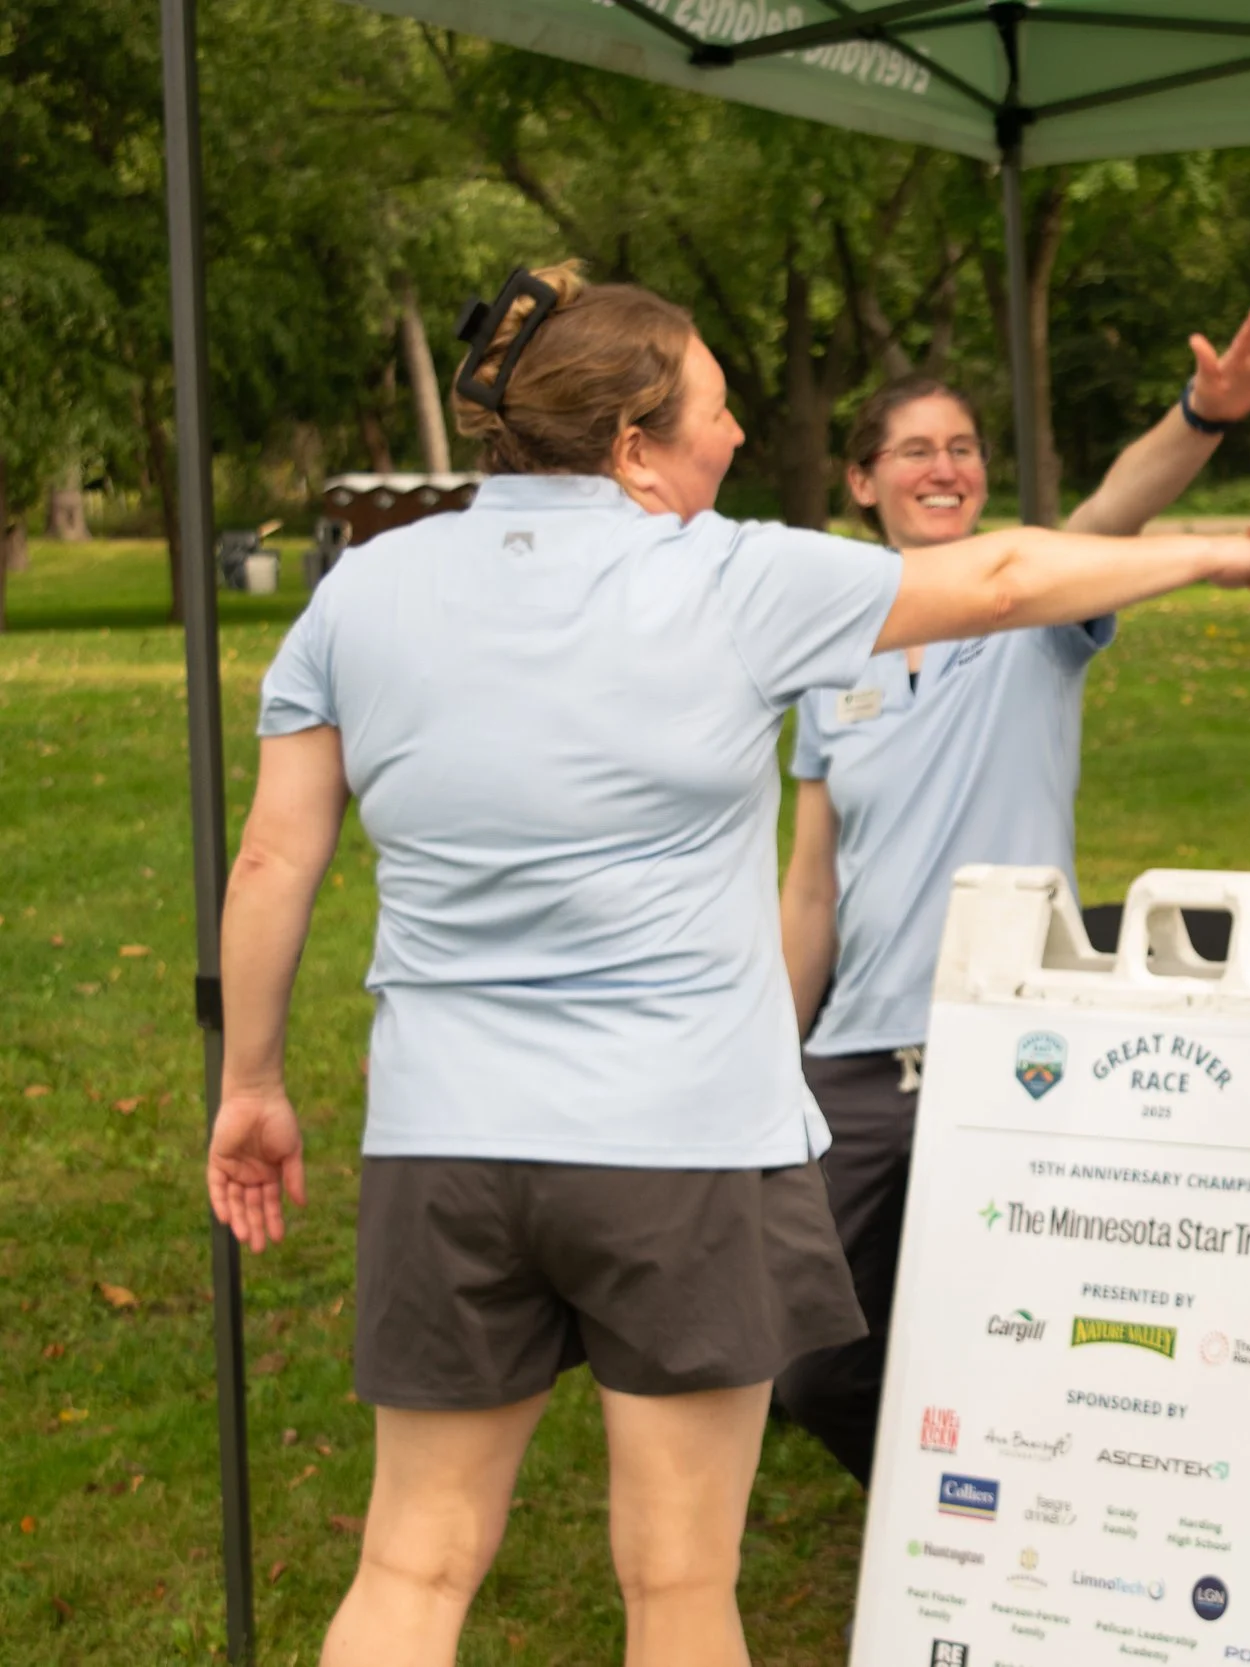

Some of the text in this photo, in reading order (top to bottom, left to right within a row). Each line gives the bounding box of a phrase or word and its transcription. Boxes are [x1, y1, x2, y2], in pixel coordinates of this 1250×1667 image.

[1092, 1032, 1232, 1090] GREAT RIVER
[1131, 1069, 1190, 1093] RACE
[1141, 1104, 1172, 1119] 2025
[1029, 1160, 1066, 1175] 15TH
[1070, 1163, 1182, 1186] ANNIVERSARY
[1008, 1201, 1044, 1235] The
[1050, 1205, 1171, 1248] Minnesota
[1177, 1217, 1232, 1253] Star
[1081, 1282, 1196, 1308] PRESENTED BY
[987, 1314, 1046, 1342] Cargill
[1075, 1318, 1173, 1356] NATURE VALLEY
[1066, 1389, 1188, 1418] SPONSORED BY
[1097, 1448, 1213, 1479] ASCENTEK
[942, 1480, 995, 1504] Colliers
[1103, 1523, 1138, 1540] Family
[1179, 1517, 1222, 1535] Harding
[1167, 1533, 1232, 1553] High School
[1072, 1570, 1146, 1597] LimnoTech
[1011, 1622, 1046, 1640] Family
